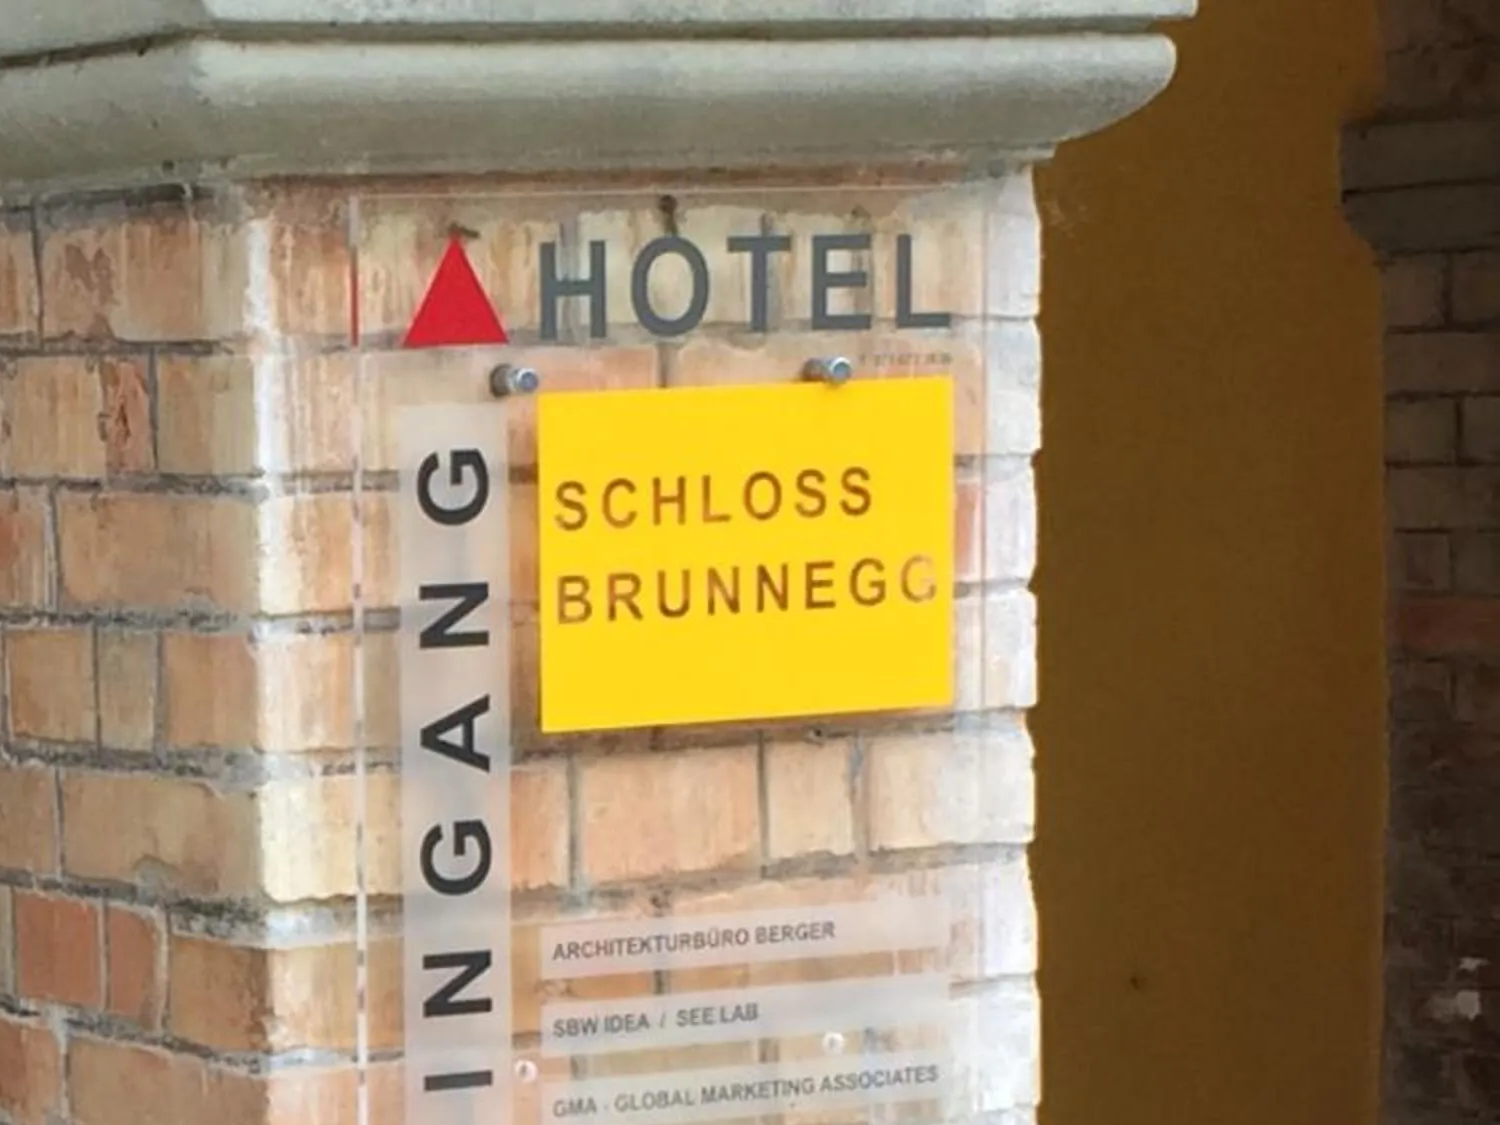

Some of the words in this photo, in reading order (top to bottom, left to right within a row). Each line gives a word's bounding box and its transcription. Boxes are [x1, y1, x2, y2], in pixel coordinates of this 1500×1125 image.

[538, 233, 951, 341] HOTEL
[554, 466, 873, 531] SCHLOSS
[557, 555, 937, 624] BRUNNEGG
[552, 927, 750, 960] ARCHITEKTURBÜRO
[755, 921, 836, 944] BERGER
[553, 1017, 598, 1038] SBW
[604, 1013, 650, 1033] IDEA
[675, 1006, 713, 1027] SEE
[719, 1003, 759, 1022] LAB
[553, 1097, 598, 1118] GMA
[614, 1089, 696, 1112] GLOBAL
[701, 1077, 815, 1105] MARKETING
[819, 1064, 940, 1092] ASSOCIATES
